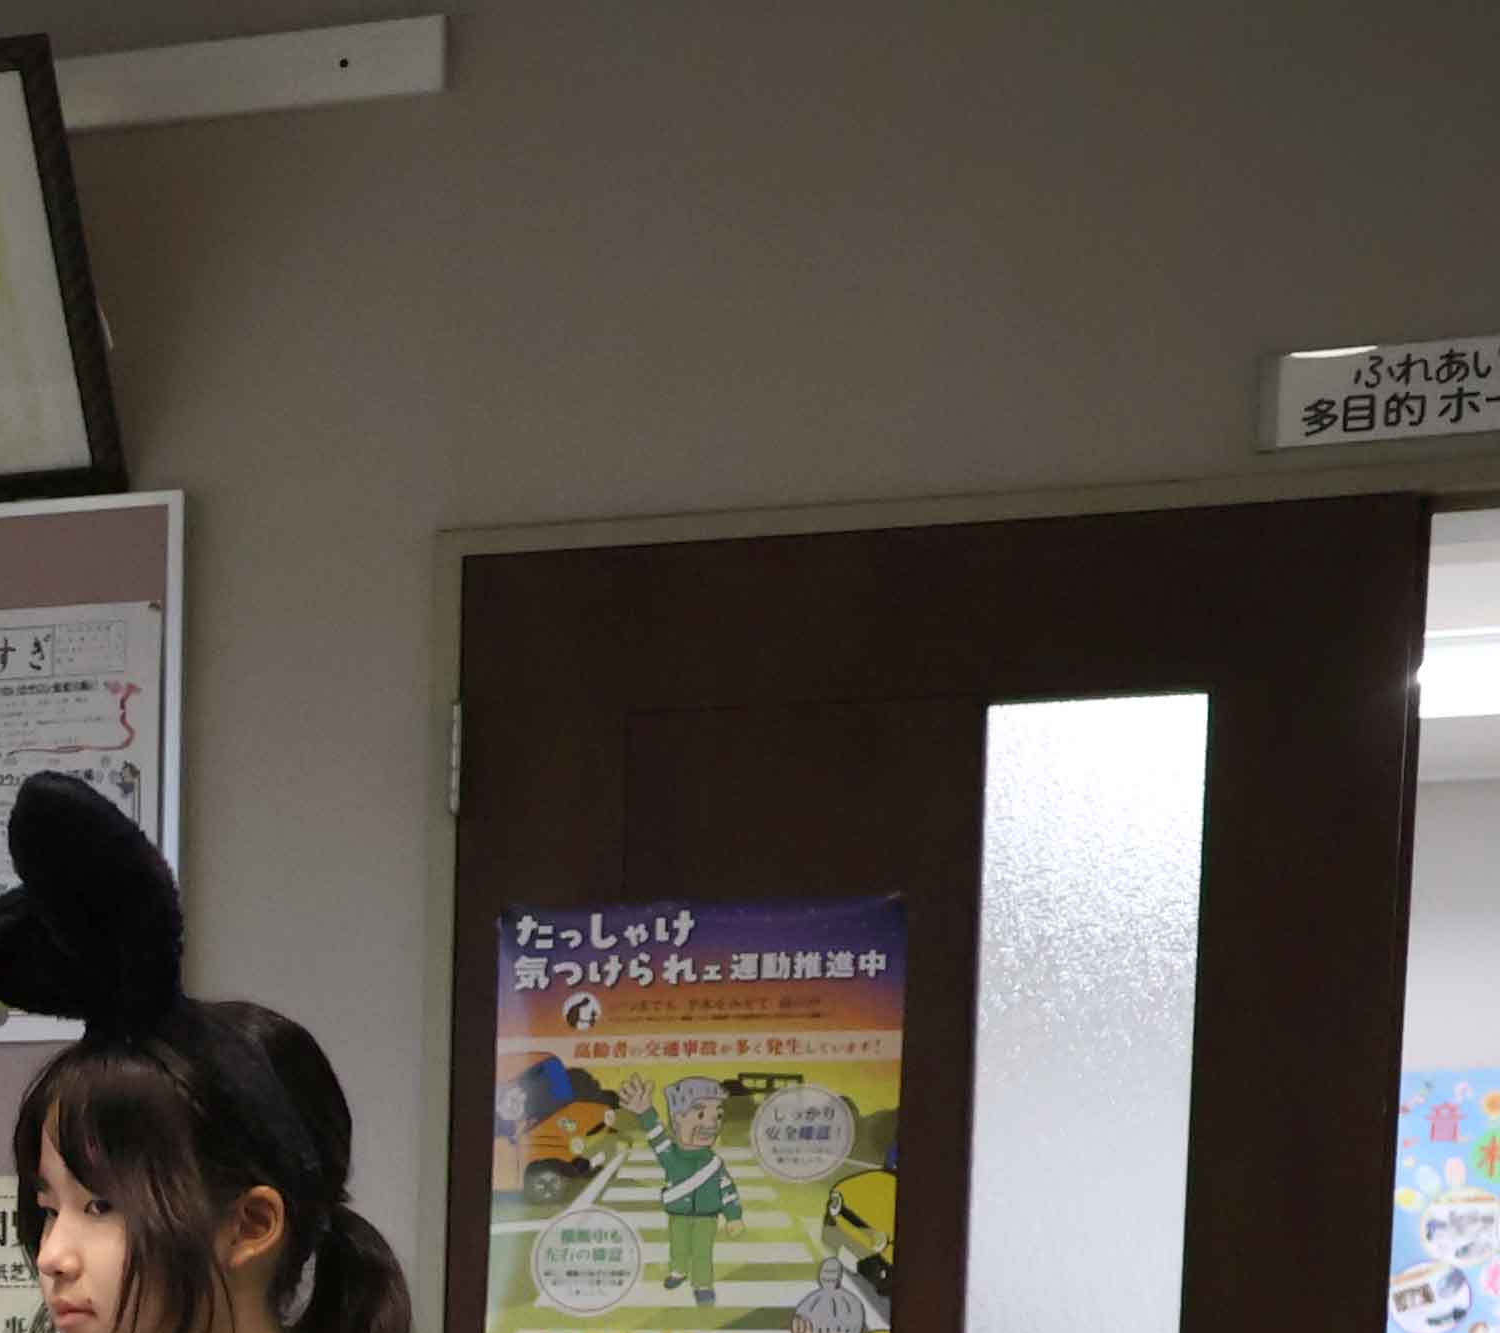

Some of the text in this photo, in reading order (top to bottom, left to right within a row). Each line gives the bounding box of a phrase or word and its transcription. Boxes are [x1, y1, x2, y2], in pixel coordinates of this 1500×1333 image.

[515, 908, 696, 950] たっしゃけ
